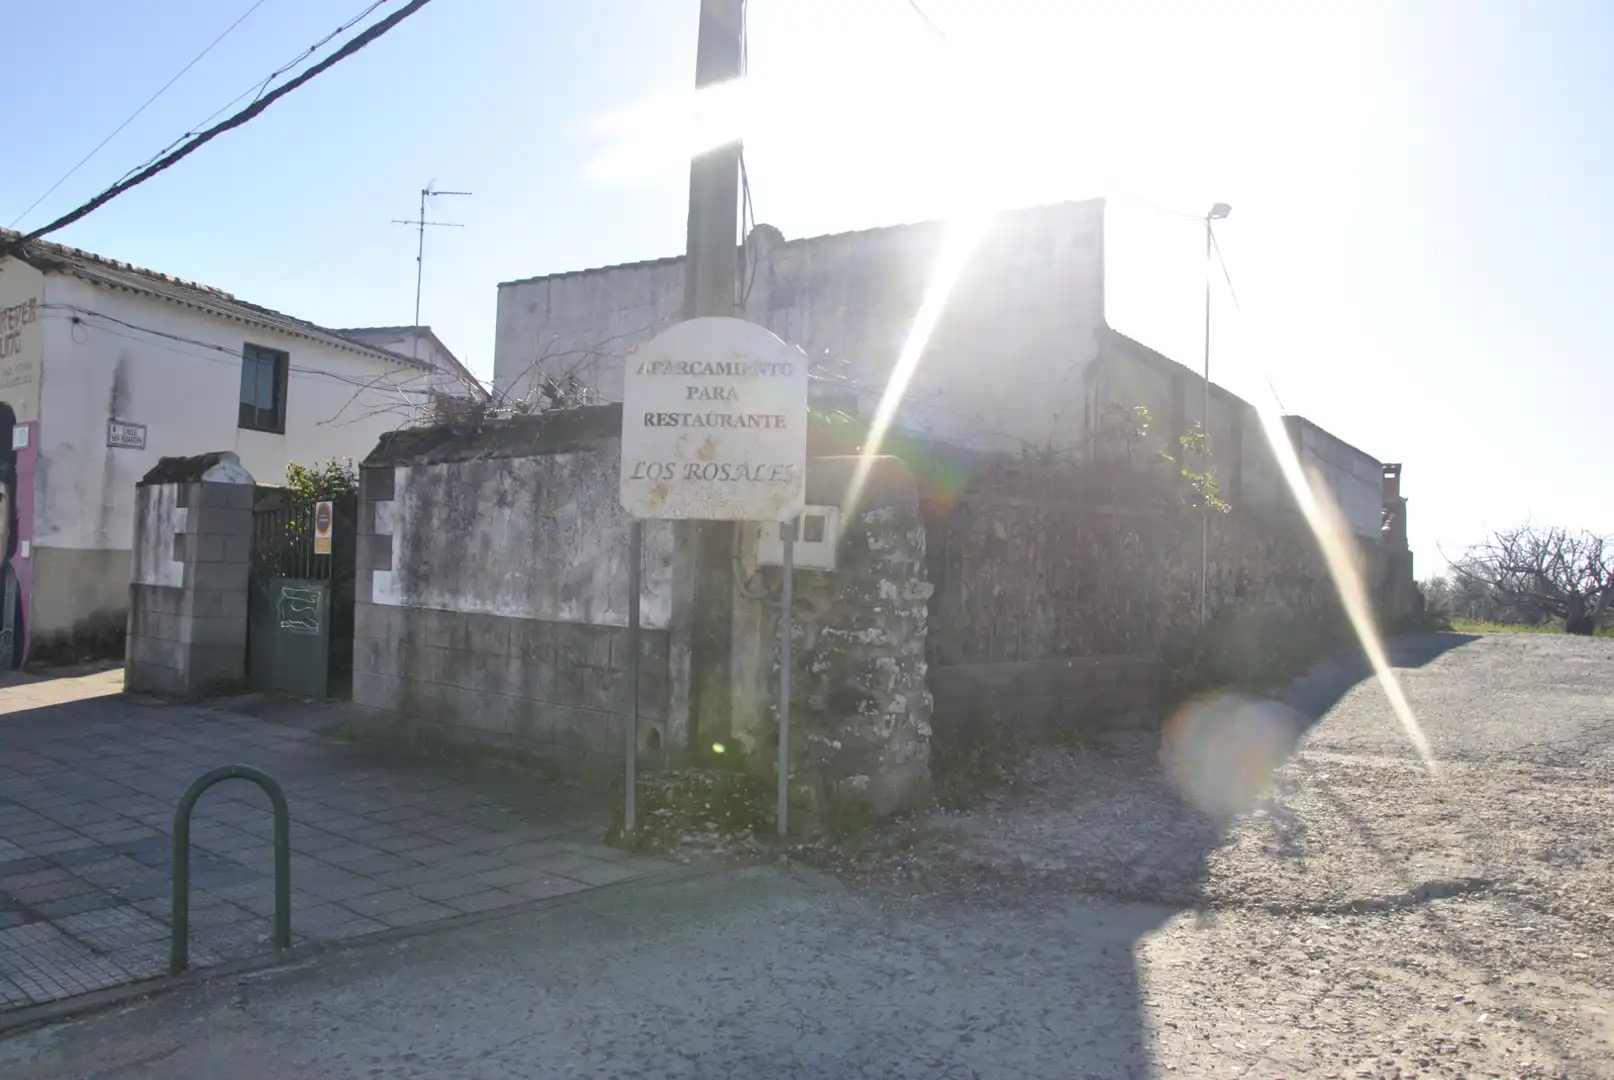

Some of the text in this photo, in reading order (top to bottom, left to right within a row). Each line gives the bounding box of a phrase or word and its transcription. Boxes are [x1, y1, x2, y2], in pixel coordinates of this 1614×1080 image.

[686, 386, 739, 401] PARA
[644, 413, 786, 429] RESTAURANTE
[630, 462, 794, 482] LOS ROSALES
